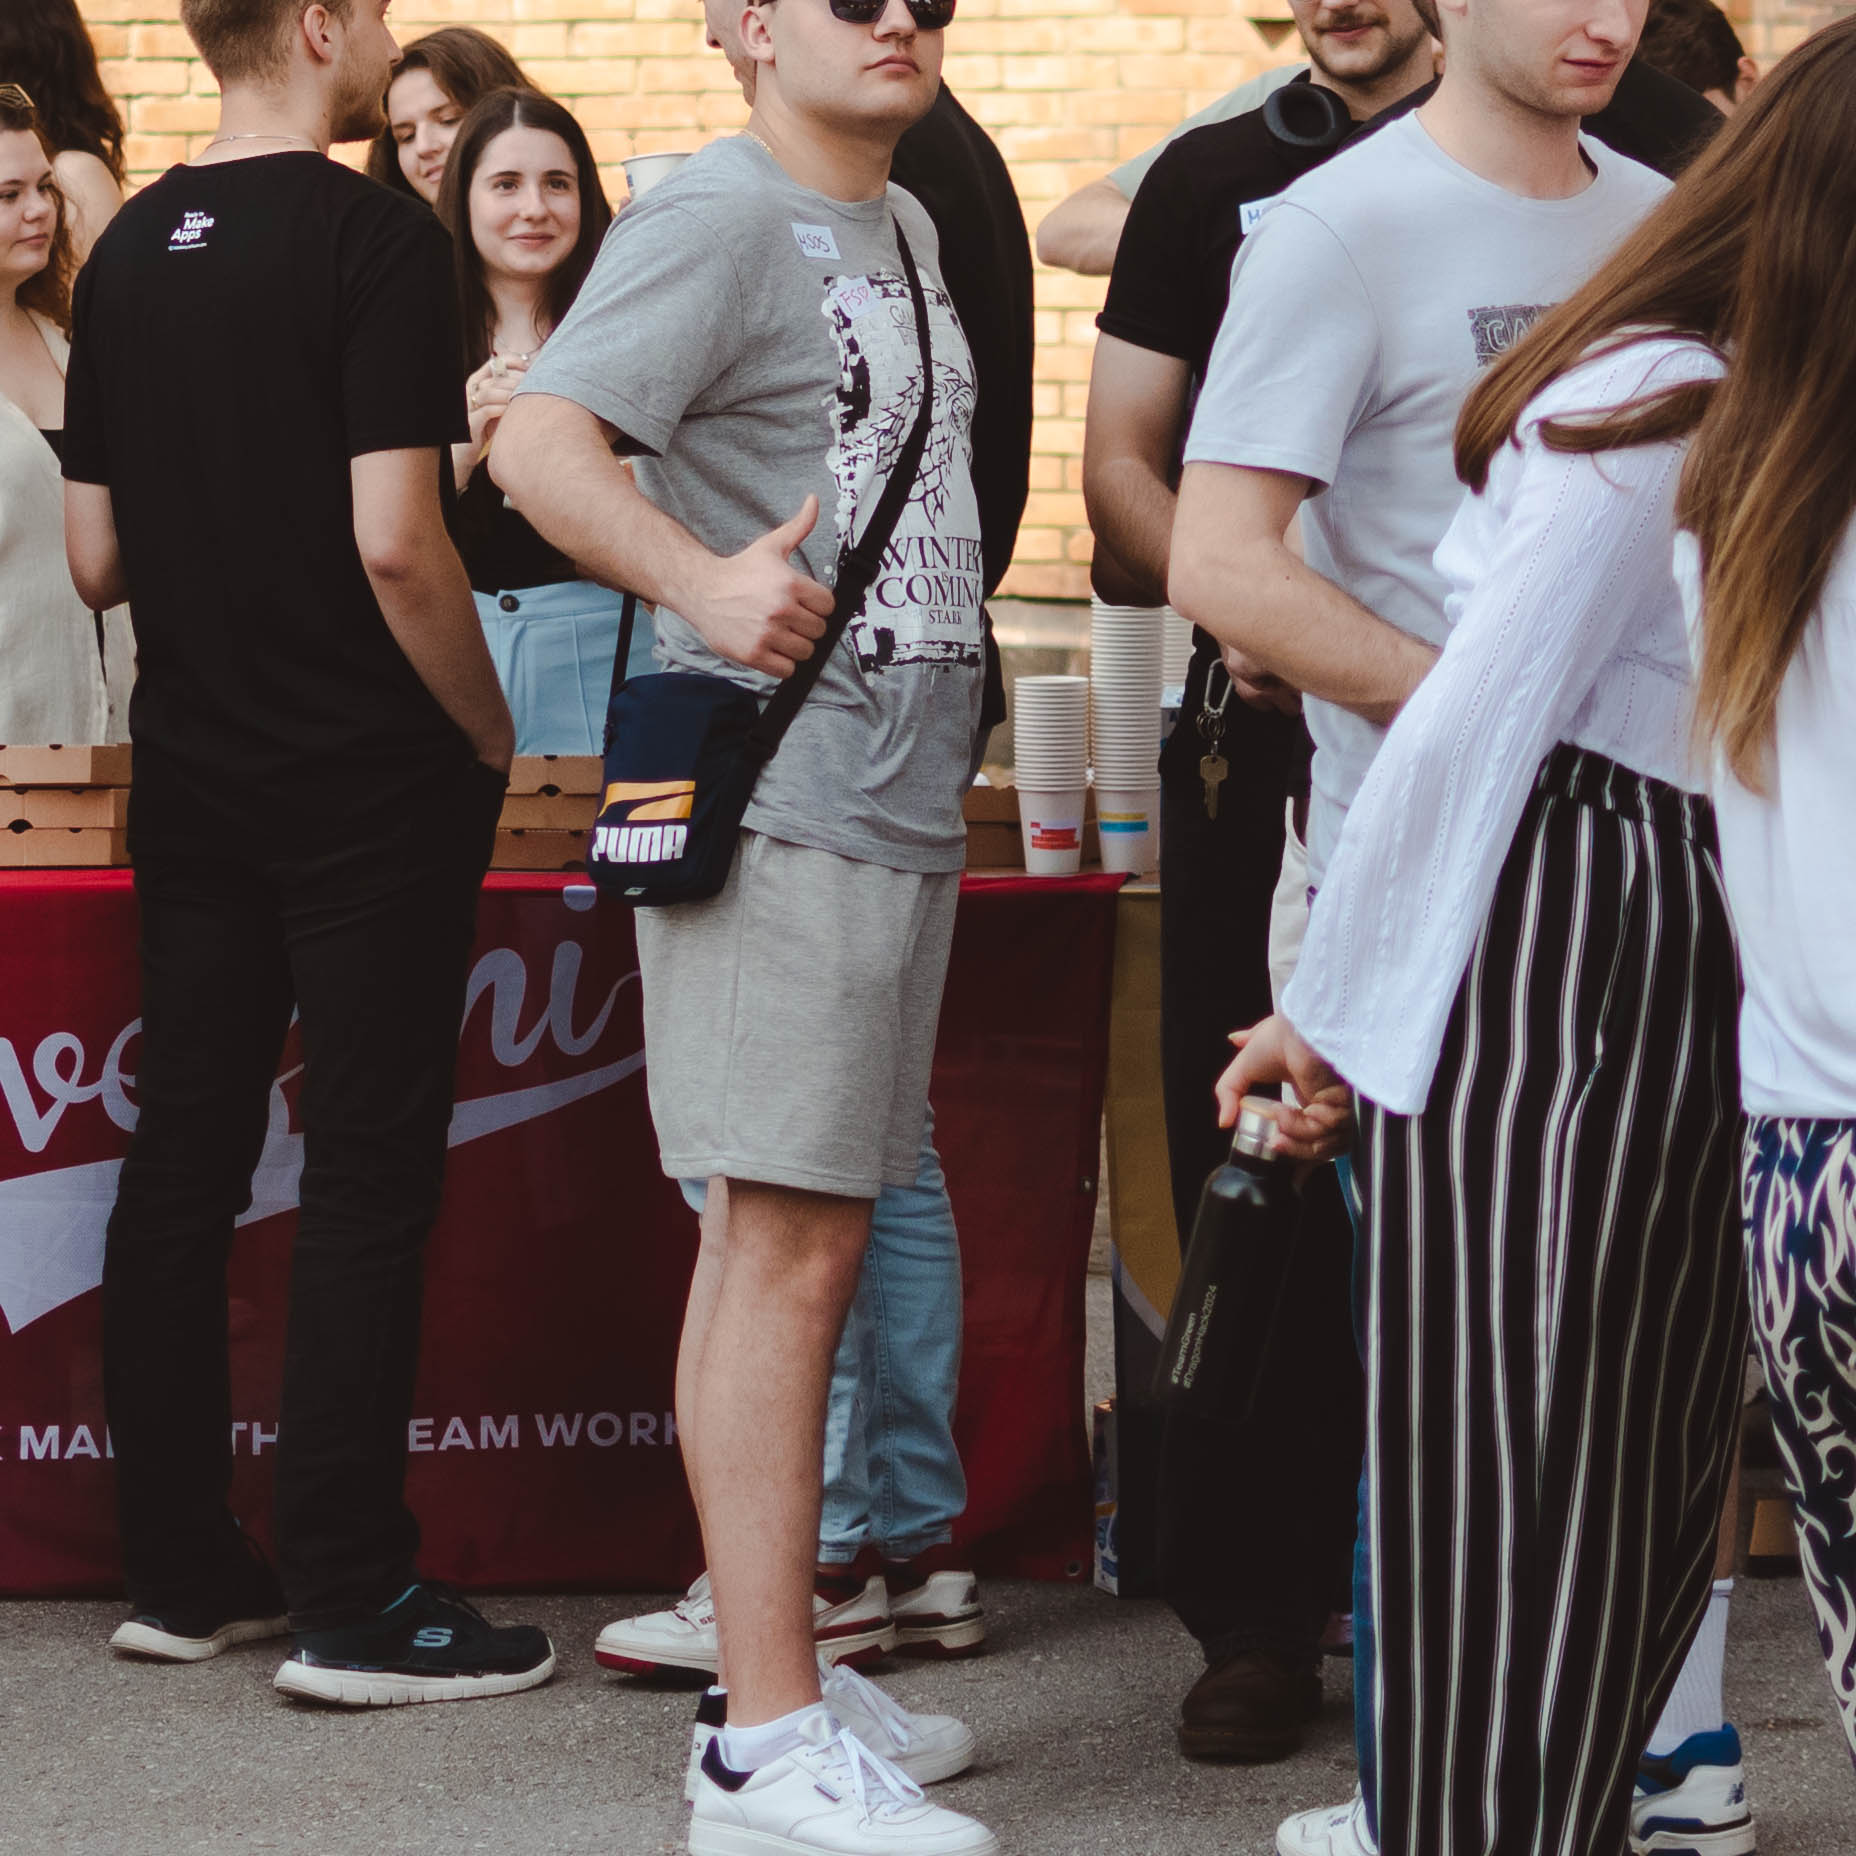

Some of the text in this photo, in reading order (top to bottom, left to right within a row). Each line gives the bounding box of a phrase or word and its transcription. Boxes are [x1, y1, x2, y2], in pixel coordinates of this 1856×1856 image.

[170, 228, 202, 244] Apps
[183, 216, 215, 230] Make
[879, 536, 982, 574] WINTER
[591, 824, 688, 863] PUMA
[407, 1414, 520, 1452] EAM
